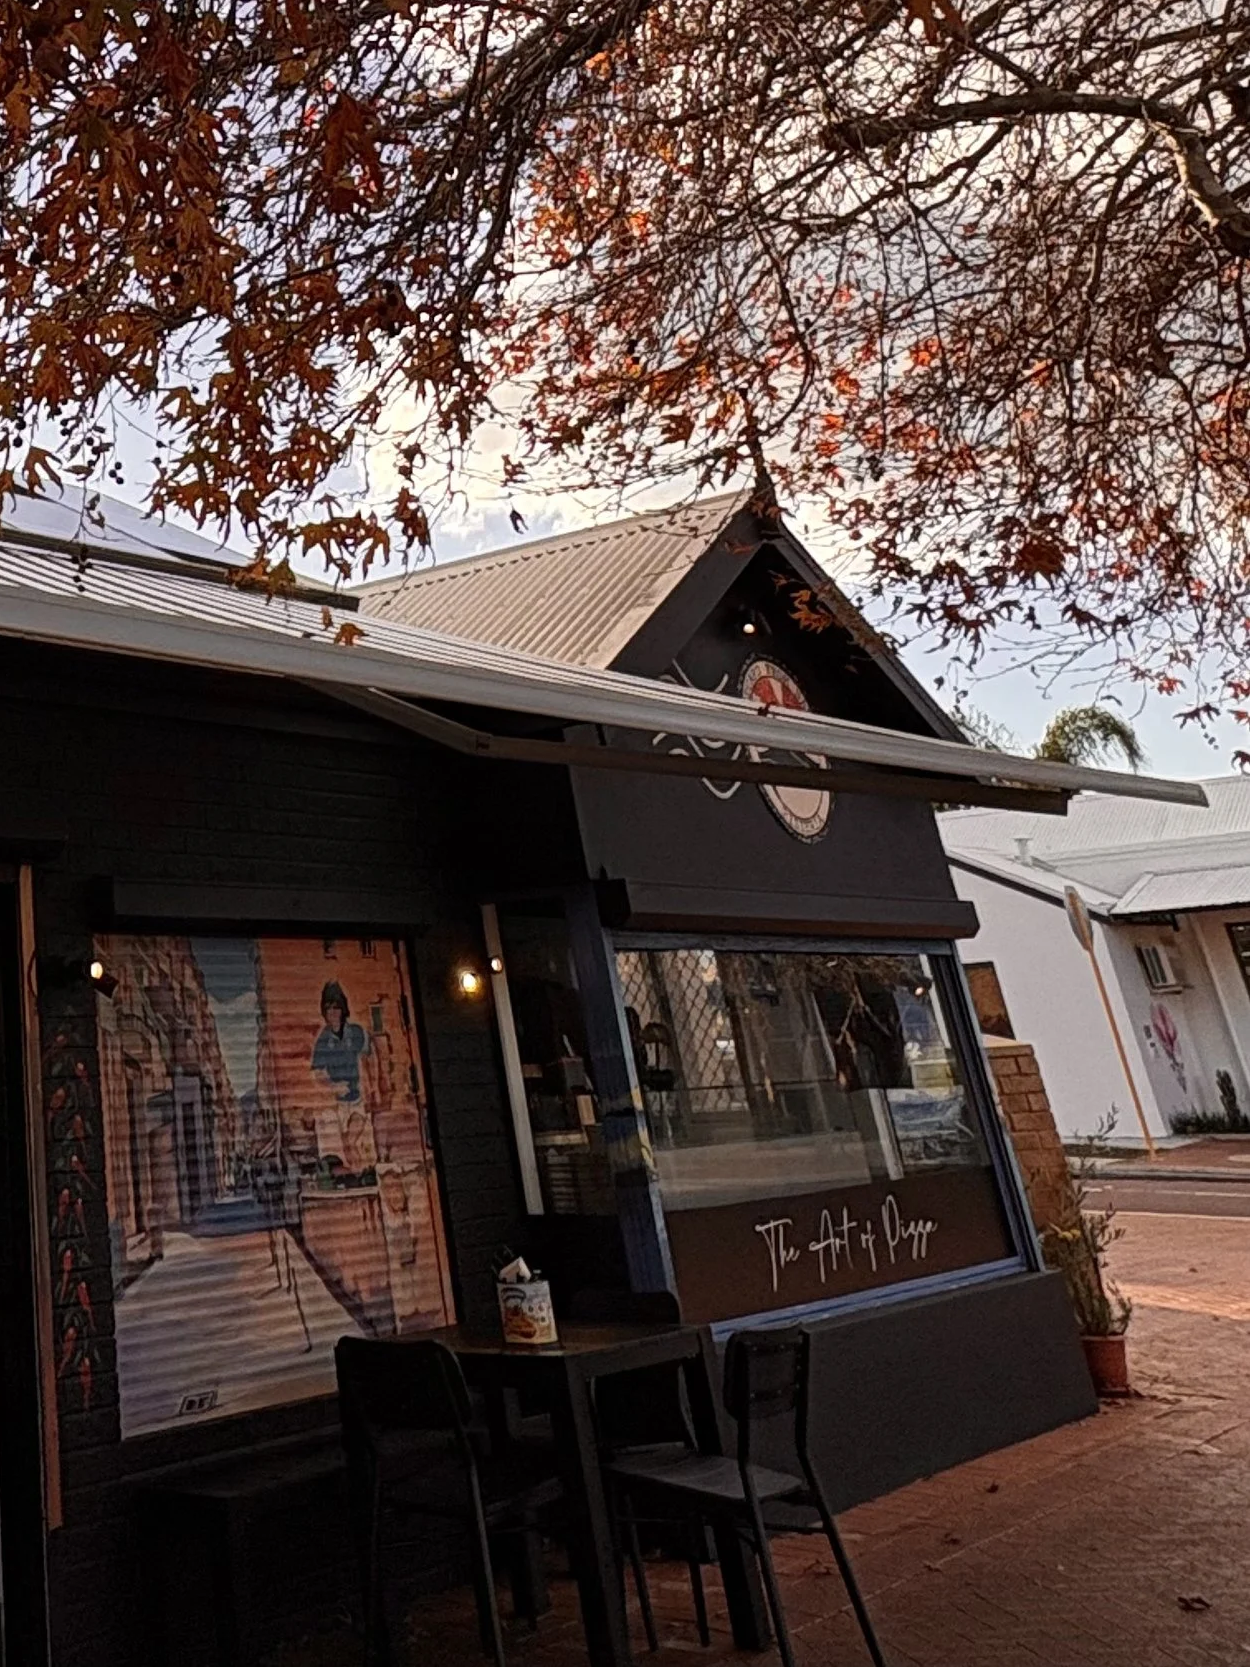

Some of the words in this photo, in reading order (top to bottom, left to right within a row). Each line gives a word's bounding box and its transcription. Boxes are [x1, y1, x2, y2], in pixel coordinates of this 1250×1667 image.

[754, 1217, 800, 1293] The
[808, 1205, 859, 1284] Art
[860, 1219, 878, 1273] of
[880, 1193, 939, 1265] Pizza
